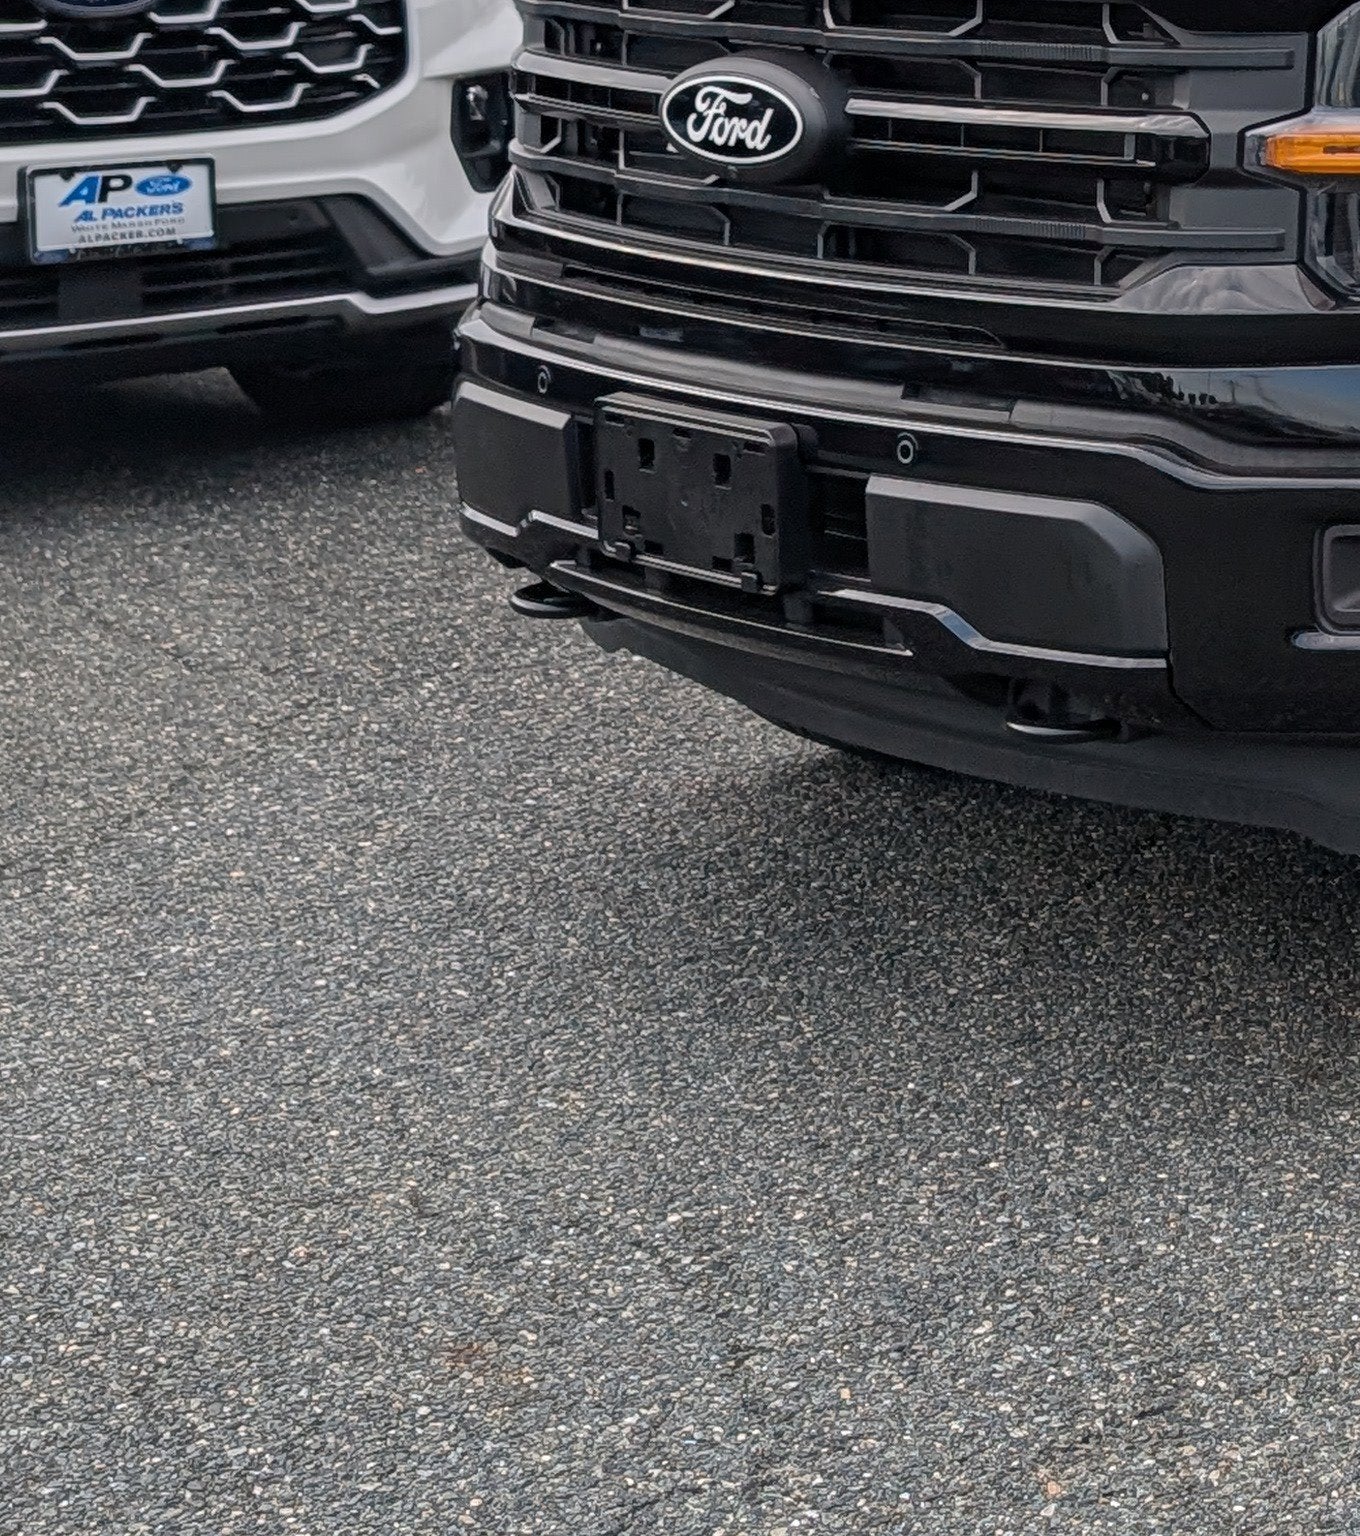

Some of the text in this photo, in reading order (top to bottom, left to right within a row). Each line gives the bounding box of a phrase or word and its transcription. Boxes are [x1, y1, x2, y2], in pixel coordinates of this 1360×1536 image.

[686, 85, 774, 151] Ford
[59, 175, 132, 206] AP
[79, 228, 175, 242] ALPACKER.COM
